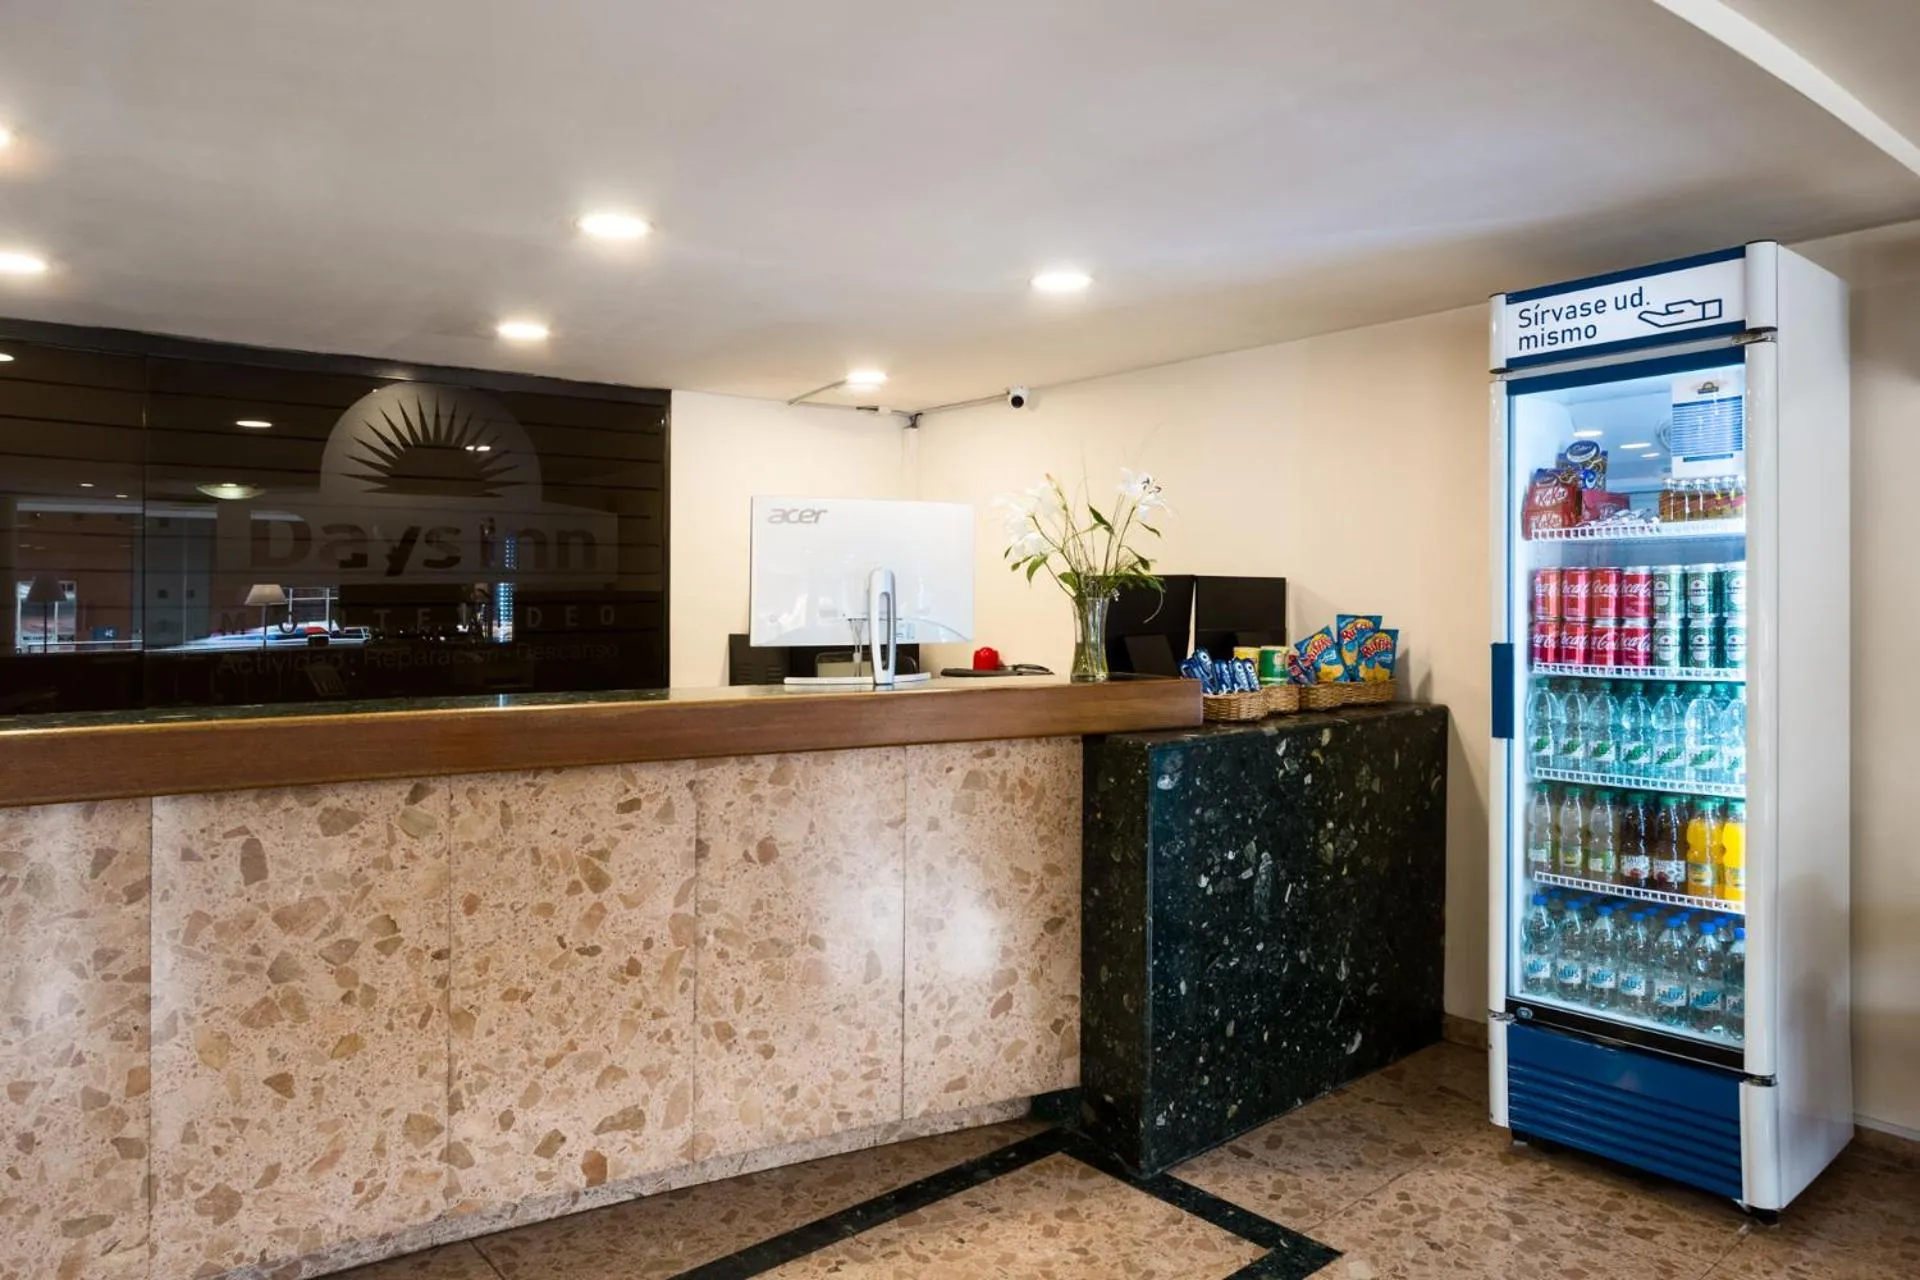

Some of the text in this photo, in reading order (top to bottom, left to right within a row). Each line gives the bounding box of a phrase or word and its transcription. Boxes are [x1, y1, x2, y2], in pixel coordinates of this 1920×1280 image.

[1518, 286, 1651, 329] Sírvase ud.
[1518, 323, 1598, 351] mismo
[768, 508, 828, 524] acer
[250, 510, 597, 577] Days Inn
[220, 604, 616, 633] MOTEDEO
